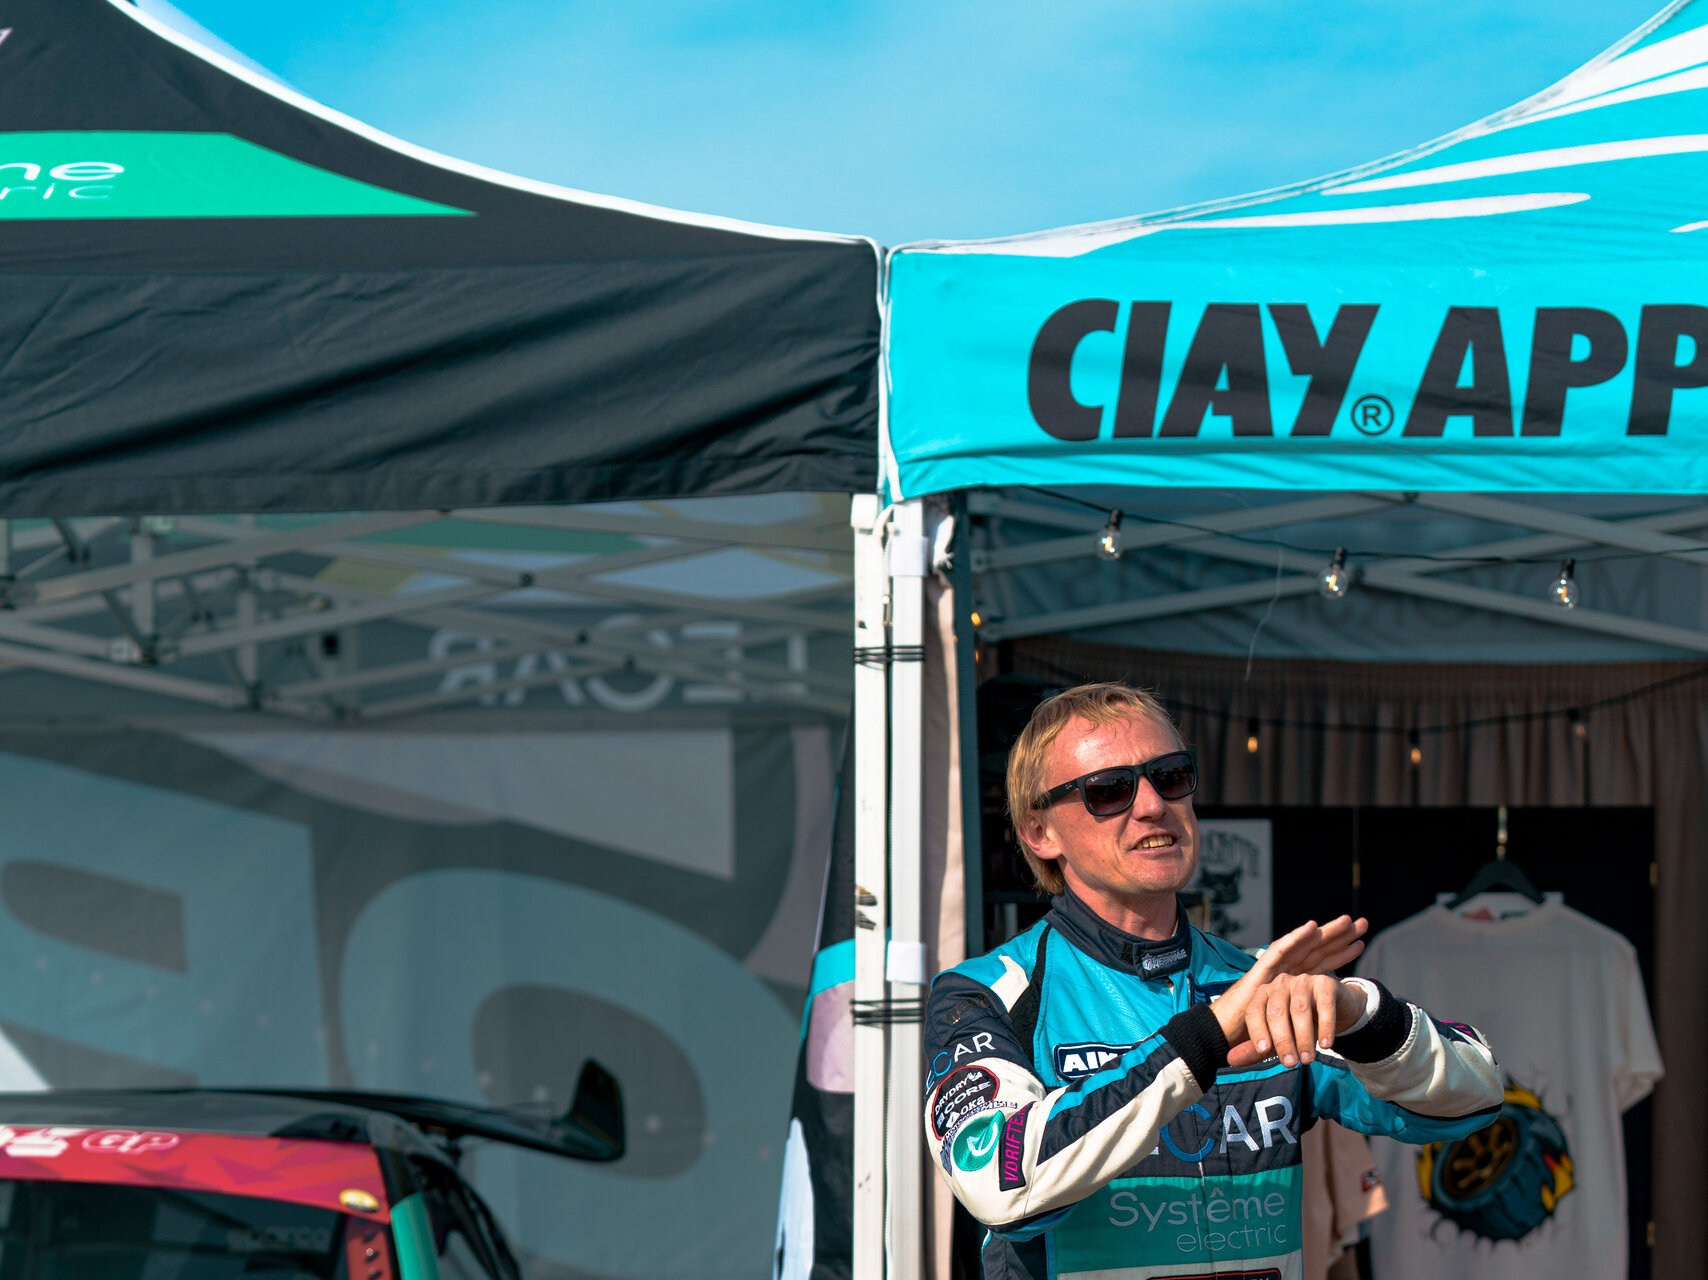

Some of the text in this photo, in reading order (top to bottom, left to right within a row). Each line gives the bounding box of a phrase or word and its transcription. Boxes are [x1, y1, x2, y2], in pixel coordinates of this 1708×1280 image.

[1149, 1095, 1298, 1163] CAR
[1109, 1188, 1285, 1232] Systême
[1176, 1221, 1287, 1253] electric
